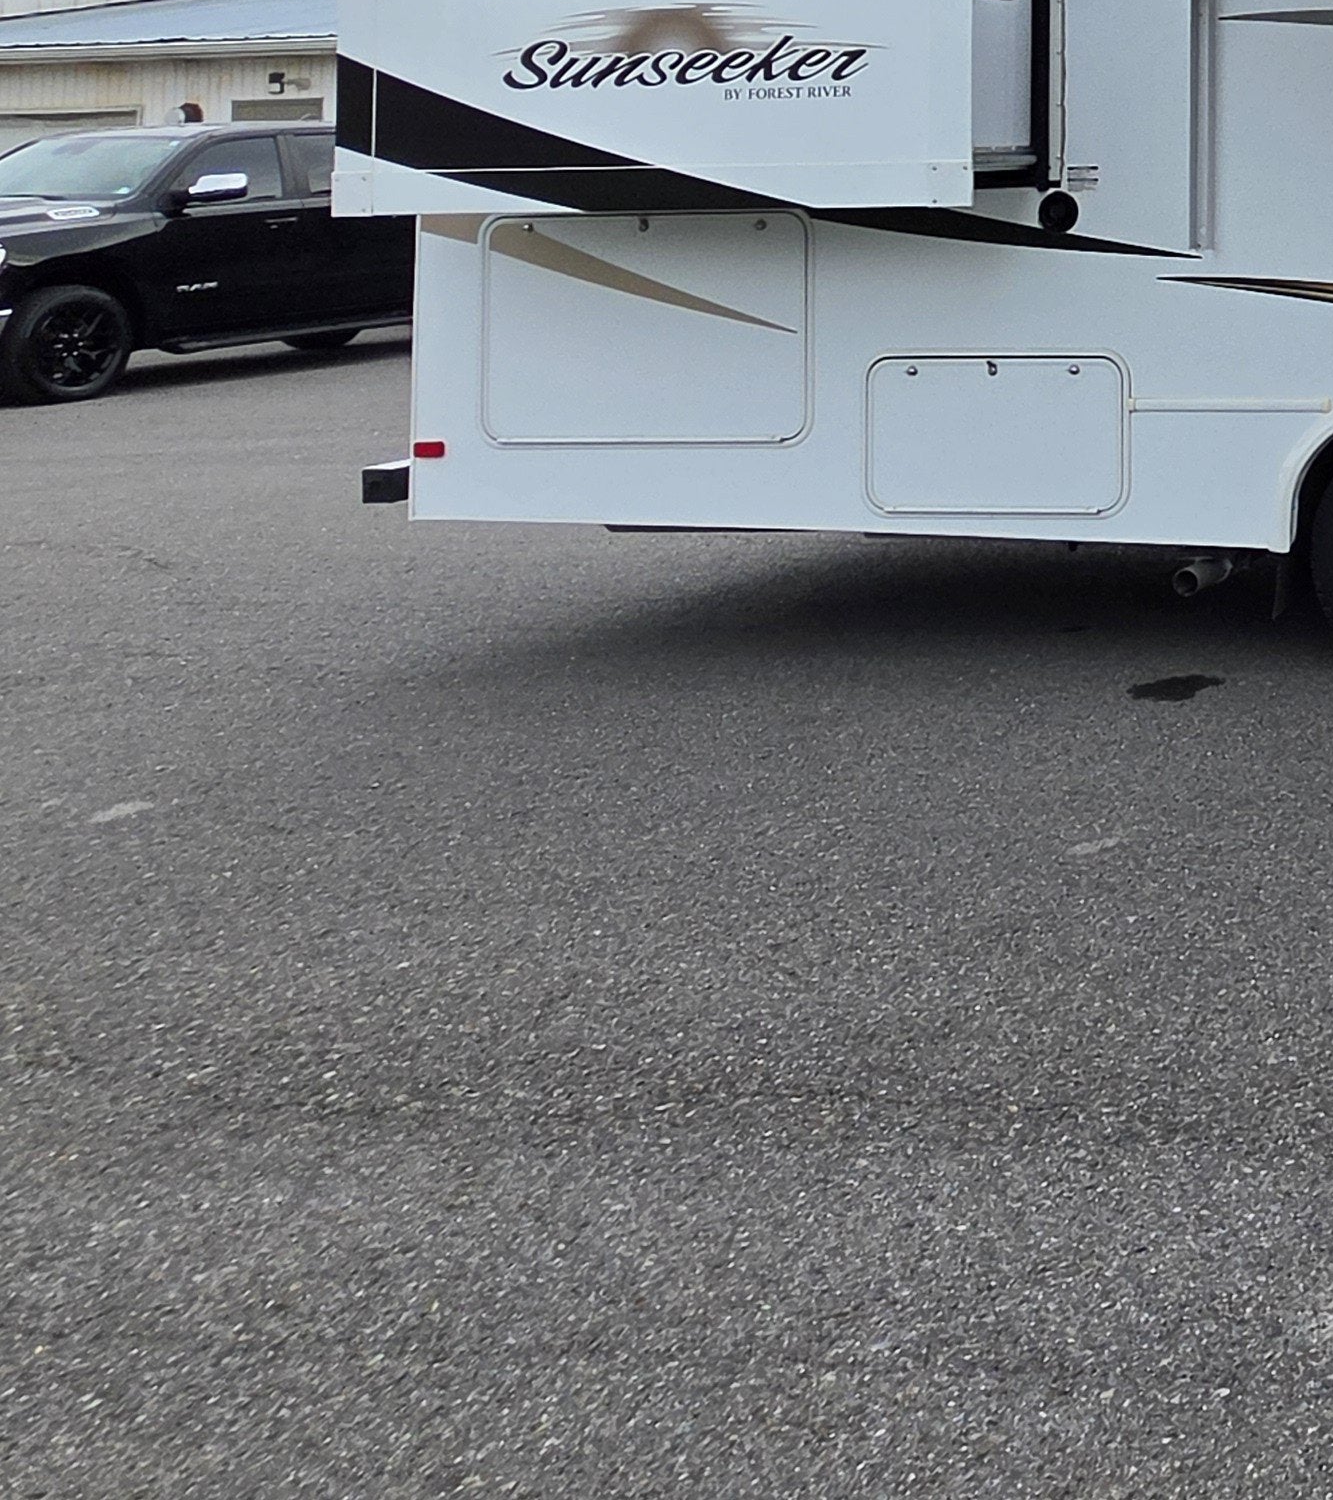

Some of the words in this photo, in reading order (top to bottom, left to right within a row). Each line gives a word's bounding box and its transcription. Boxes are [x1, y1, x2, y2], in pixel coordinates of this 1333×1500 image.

[503, 35, 868, 89] Sunseeker
[725, 89, 743, 100] BY
[748, 87, 803, 99] FOREST
[808, 86, 851, 98] RIVER
